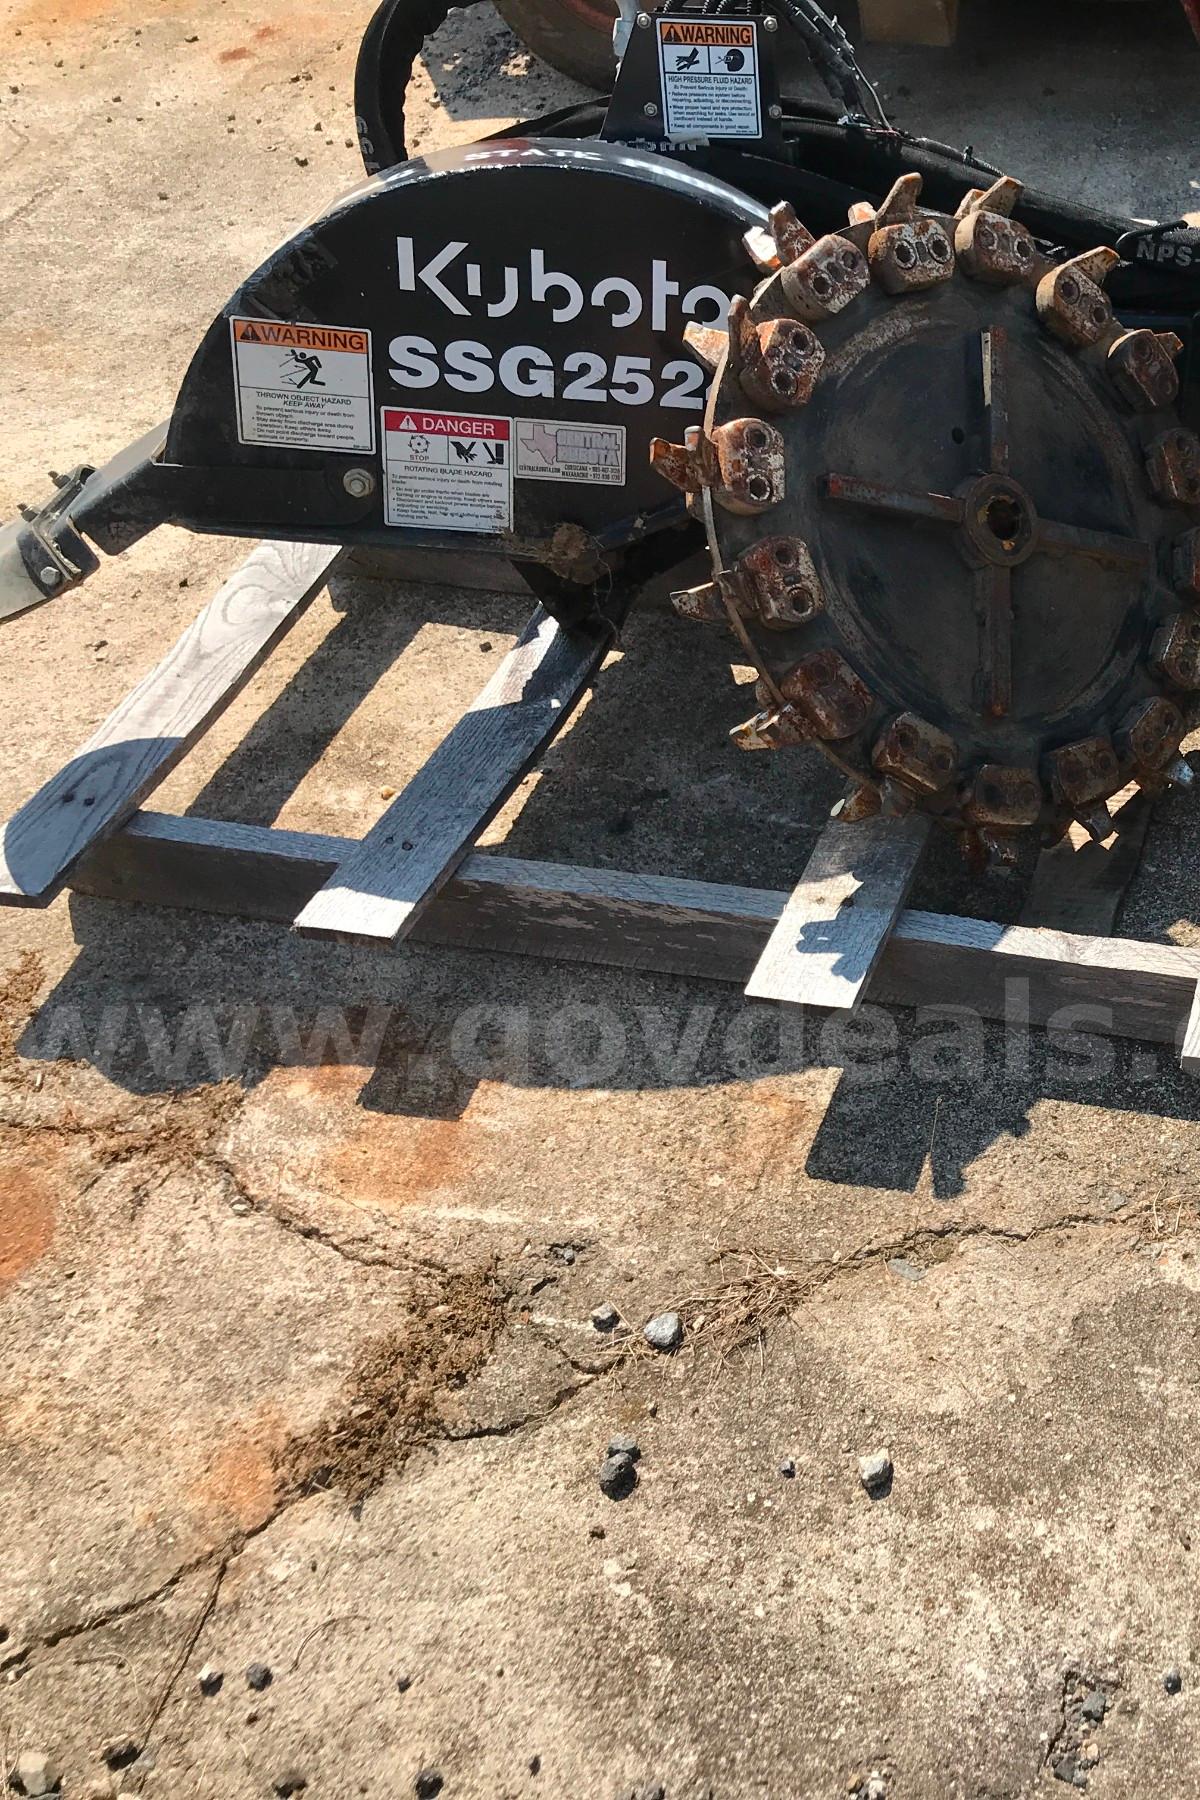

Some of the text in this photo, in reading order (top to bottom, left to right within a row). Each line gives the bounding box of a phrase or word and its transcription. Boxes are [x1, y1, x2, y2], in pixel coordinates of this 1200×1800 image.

[680, 25, 751, 44] WARNING
[260, 325, 364, 351] WARNING
[388, 335, 714, 410] SSG252
[256, 391, 351, 405] THROWN OBJECT HAZARD
[422, 417, 495, 436] DANGER
[404, 465, 438, 473] ROTATING
[464, 470, 492, 478] HAZARD
